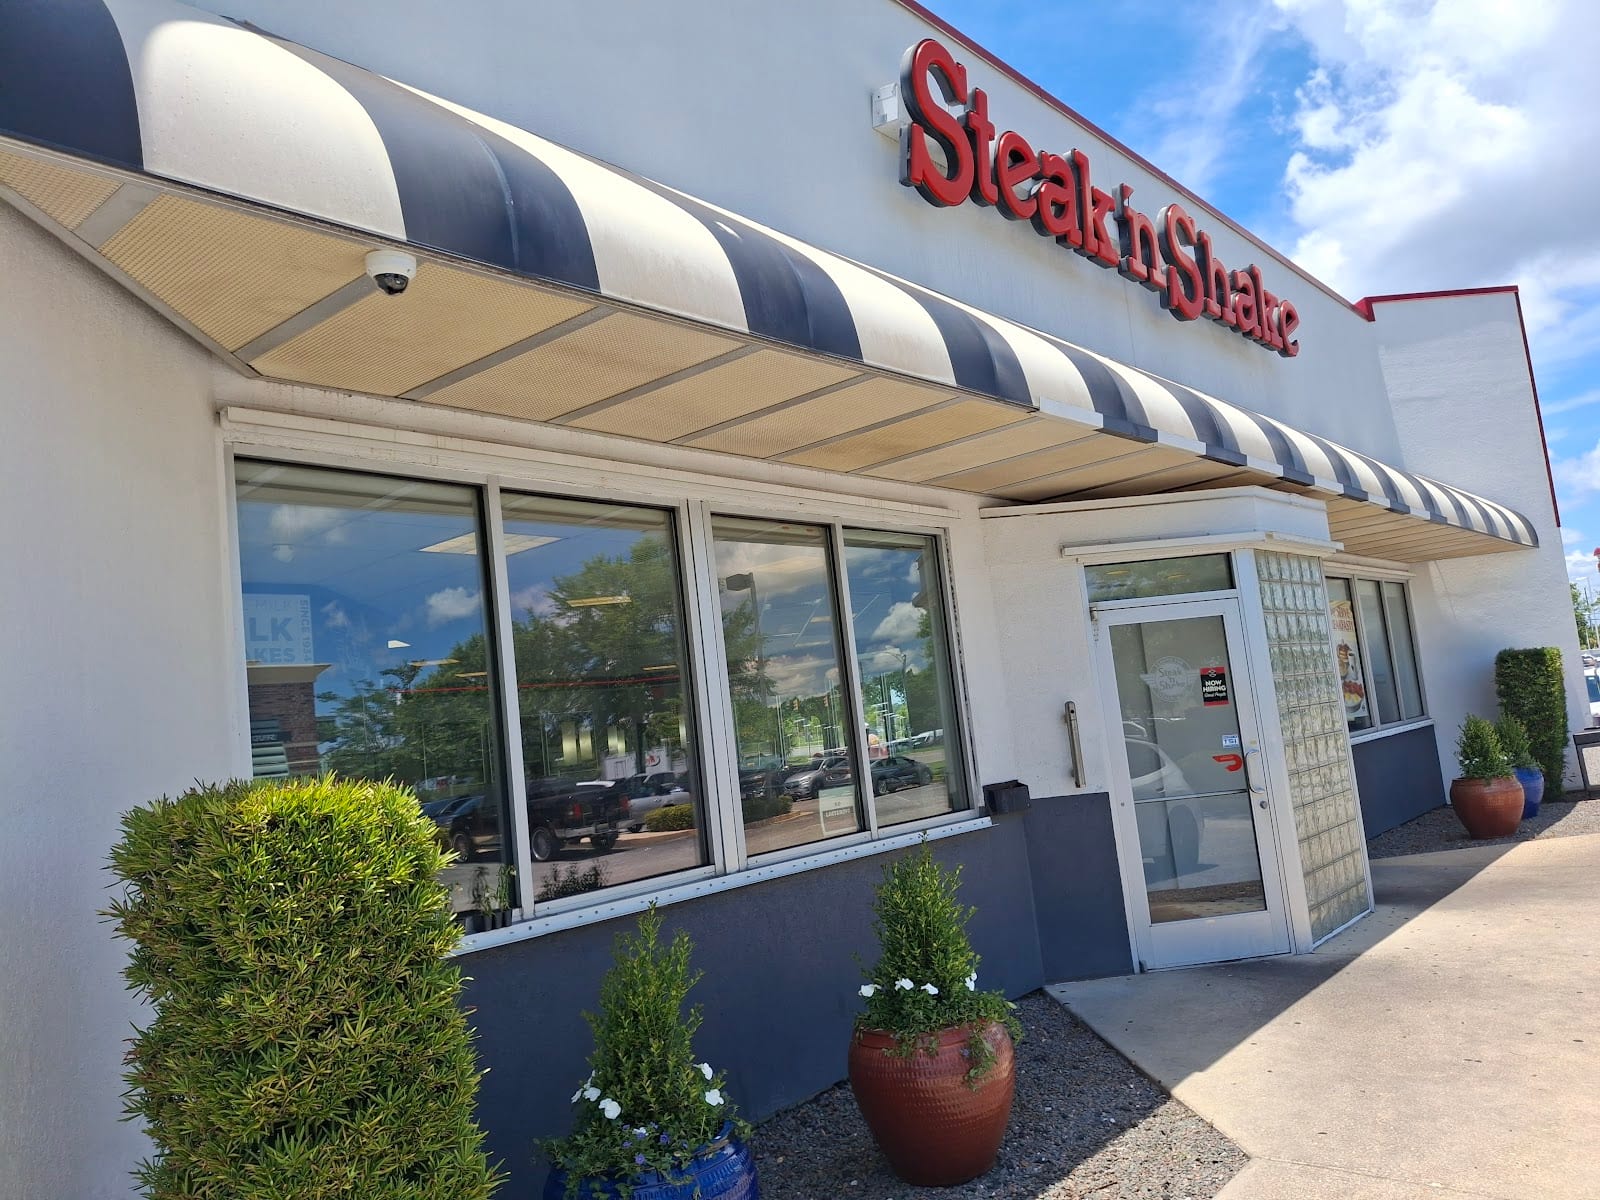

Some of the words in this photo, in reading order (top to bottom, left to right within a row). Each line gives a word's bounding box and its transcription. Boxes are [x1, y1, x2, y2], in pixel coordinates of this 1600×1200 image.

[901, 39, 1119, 268] Steak
[1160, 203, 1300, 358] Shake
[299, 599, 310, 633] SINCE
[248, 617, 294, 642] LK
[254, 647, 296, 662] KES
[1203, 685, 1226, 693] HIRING
